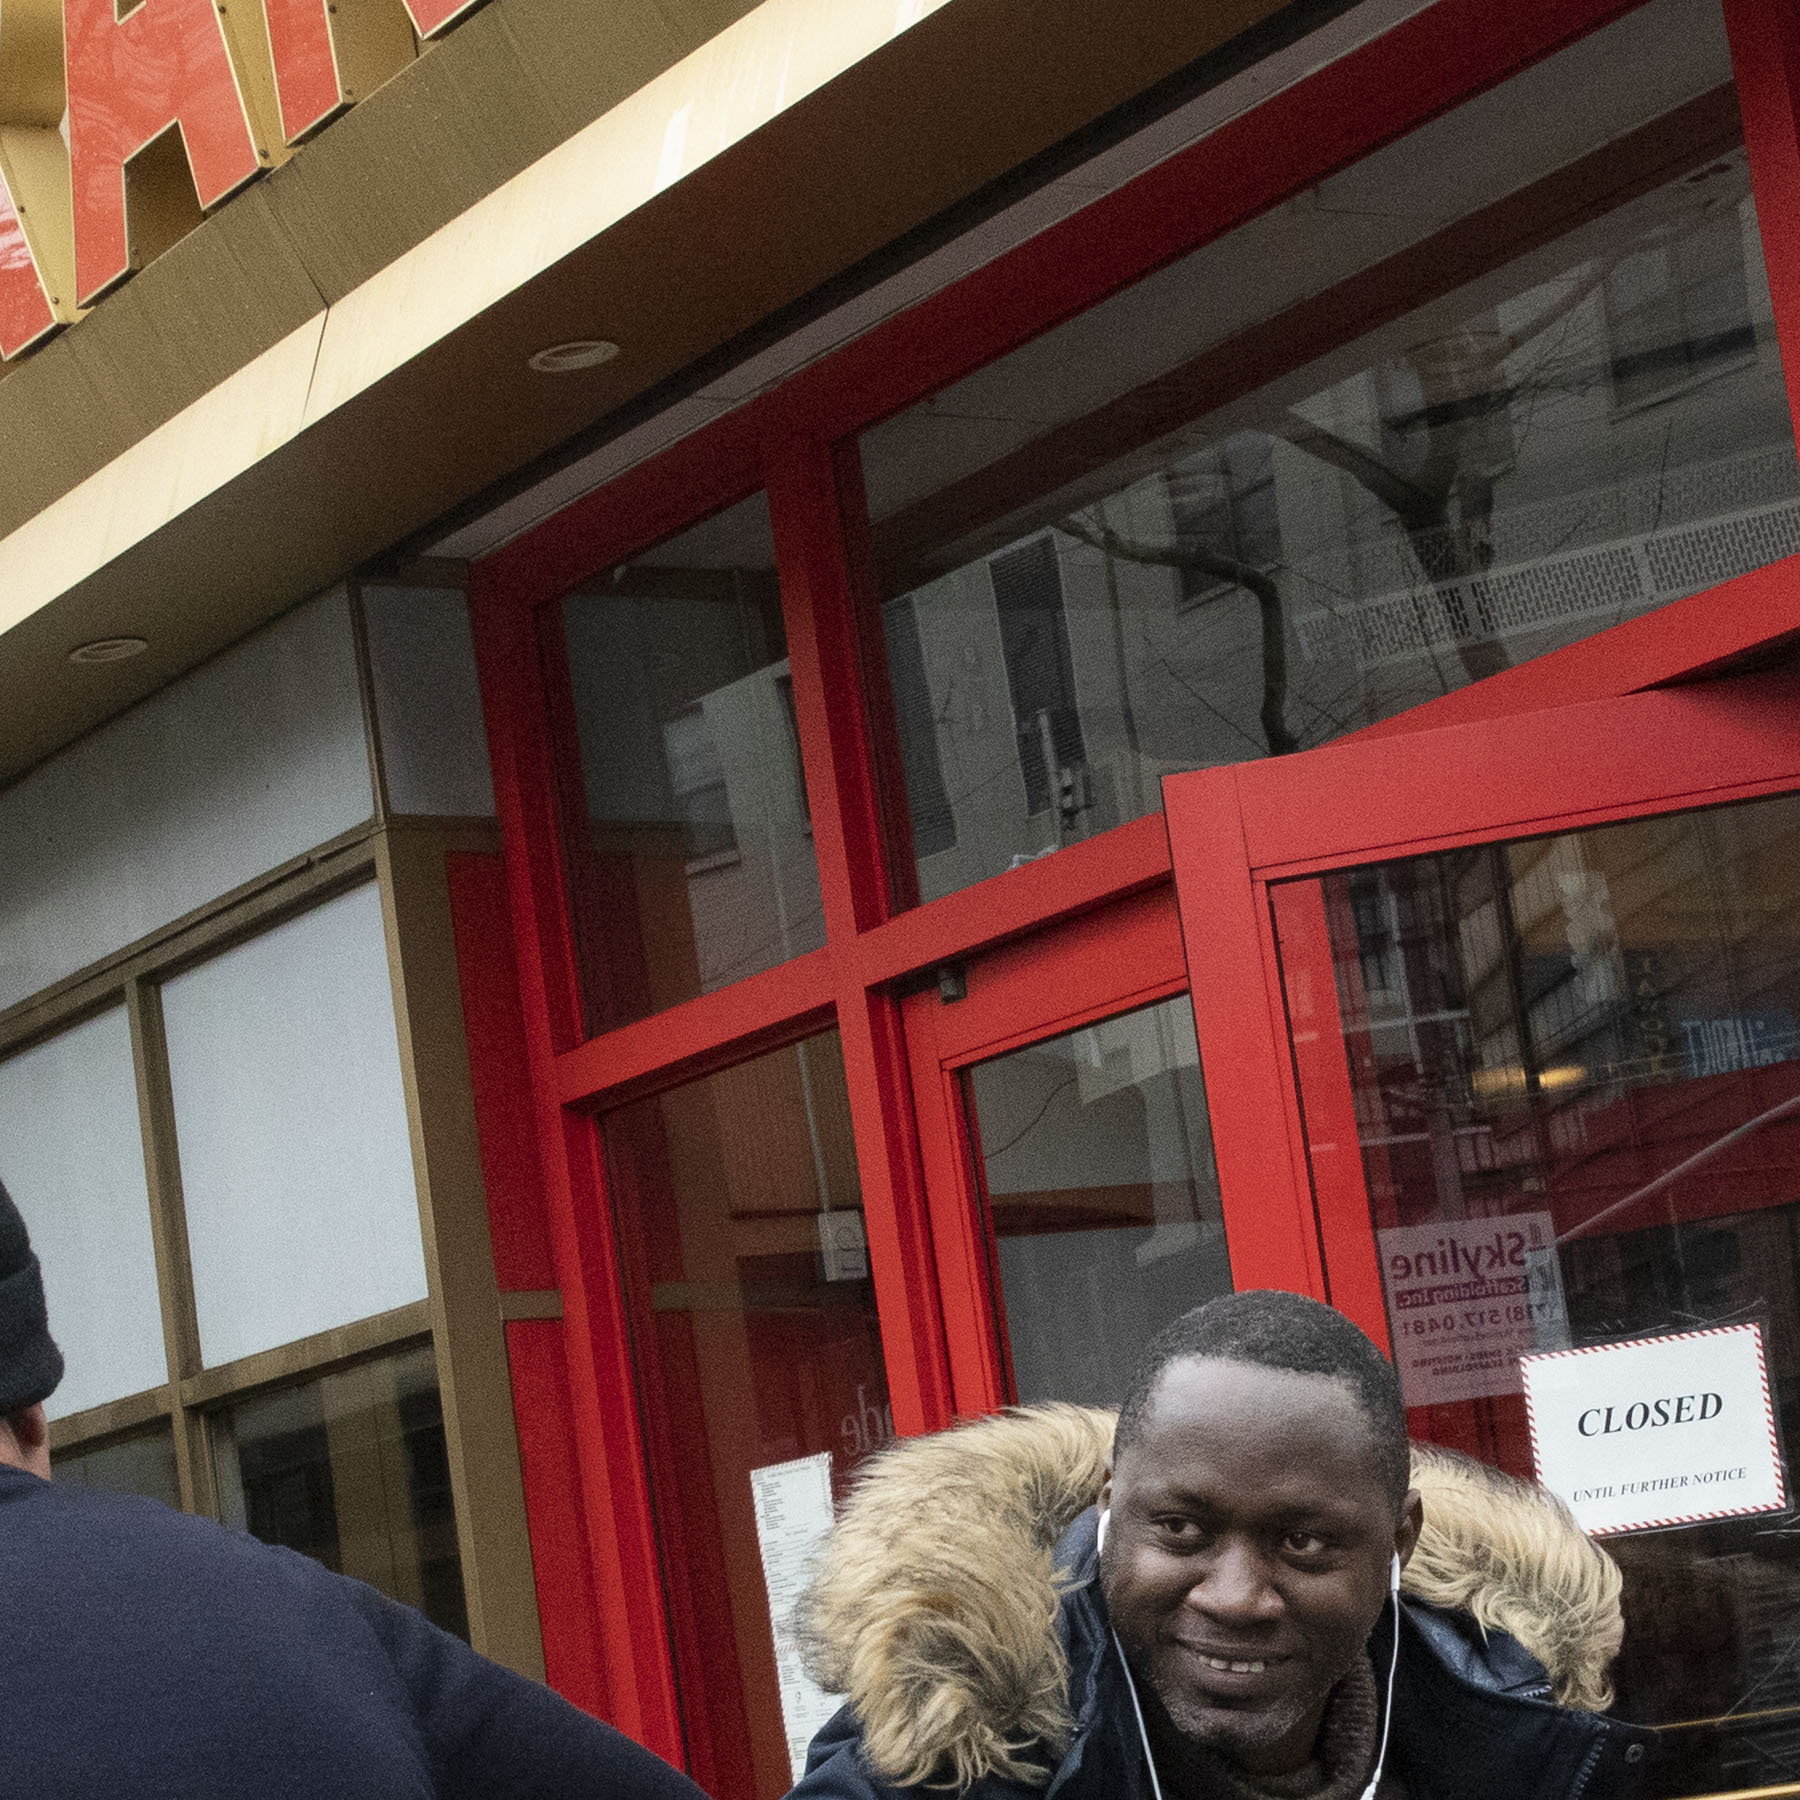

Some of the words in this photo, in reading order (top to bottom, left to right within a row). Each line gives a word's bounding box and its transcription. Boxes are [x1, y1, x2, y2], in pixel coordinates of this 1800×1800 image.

[1577, 1391, 1723, 1438] CLOSED
[1573, 1484, 1617, 1503] UNTIL
[1621, 1475, 1689, 1496] FURTHER
[1692, 1467, 1747, 1487] NOTICE
